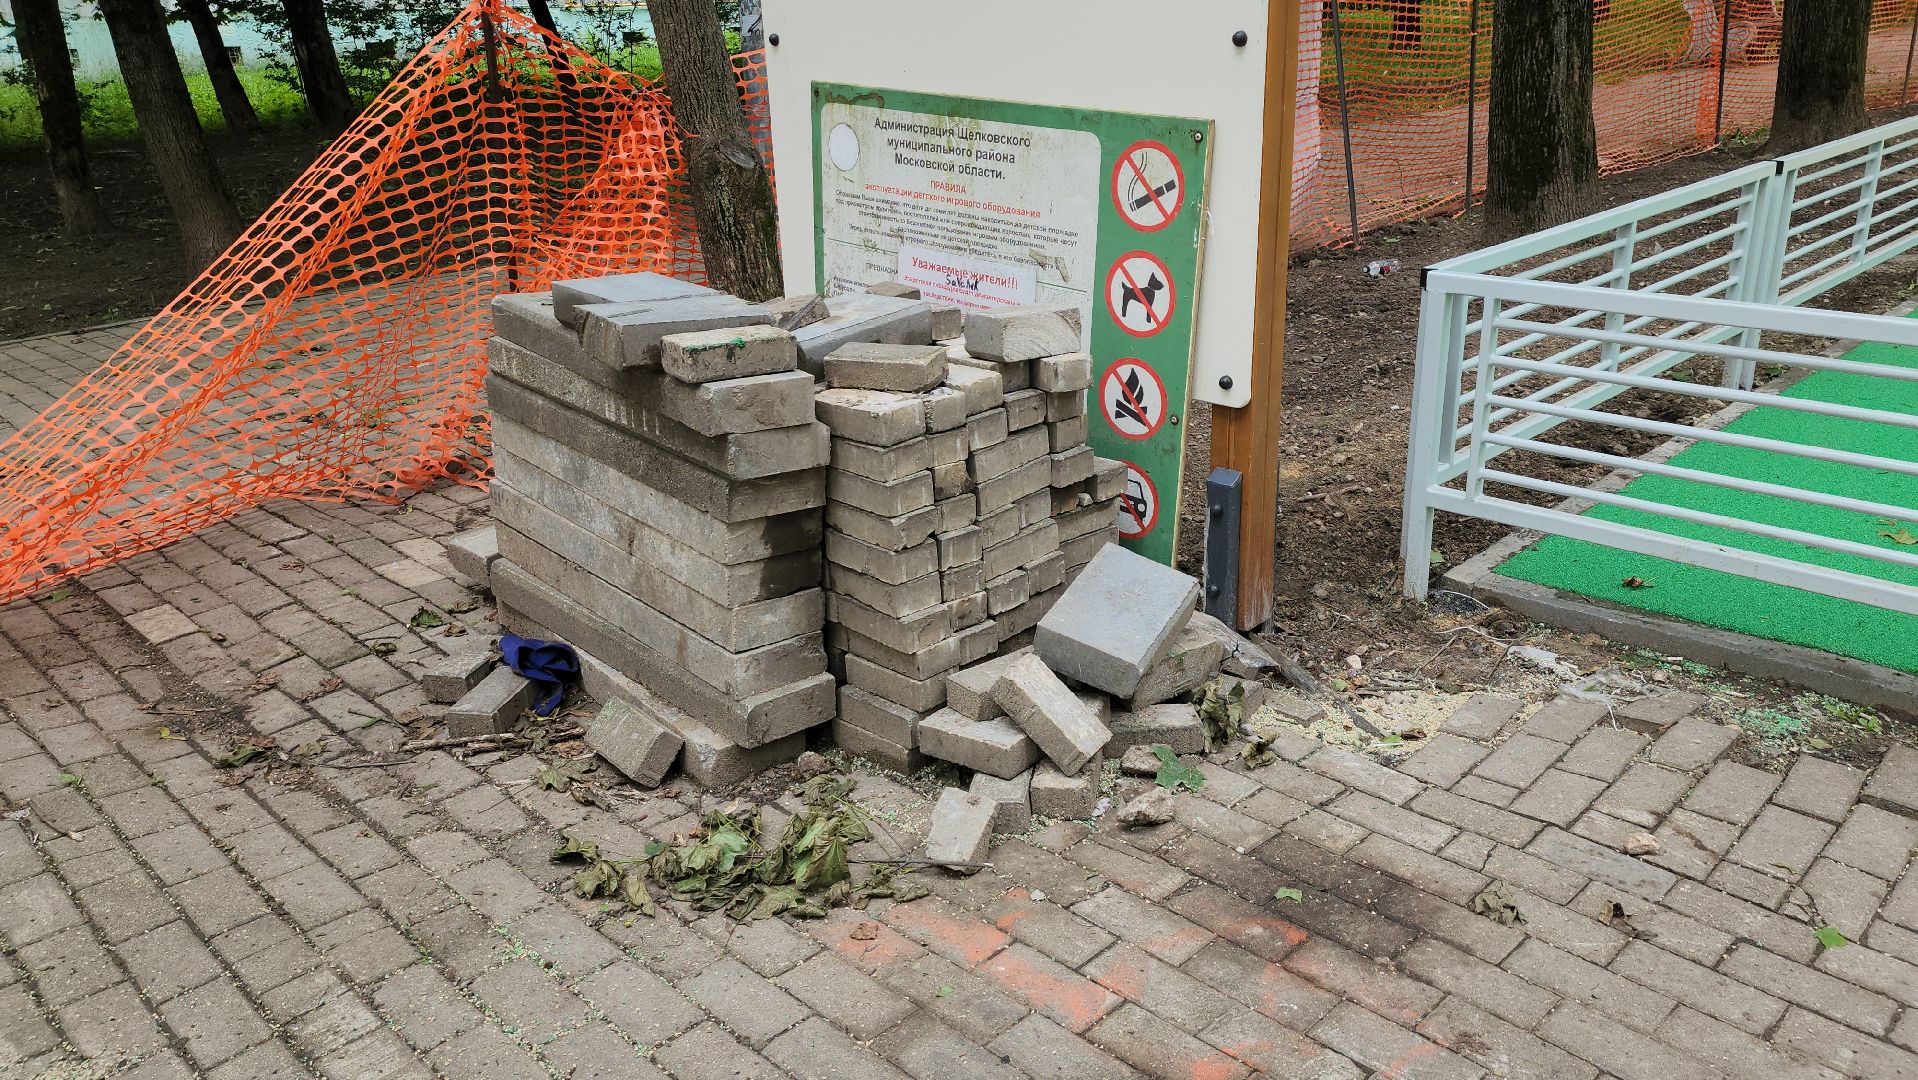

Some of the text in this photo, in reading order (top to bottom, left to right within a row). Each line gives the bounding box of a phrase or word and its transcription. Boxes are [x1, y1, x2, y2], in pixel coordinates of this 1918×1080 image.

[874, 117, 1031, 147] Администрация Щелковского
[887, 138, 1015, 164] муниципального района
[895, 153, 1006, 180] Московской области.
[930, 180, 966, 194] ПРАВИЛА
[913, 192, 944, 202] детского
[946, 197, 980, 208] игрового
[982, 203, 1040, 218] оборудования
[912, 256, 1018, 290] Уважаемые жители!!!
